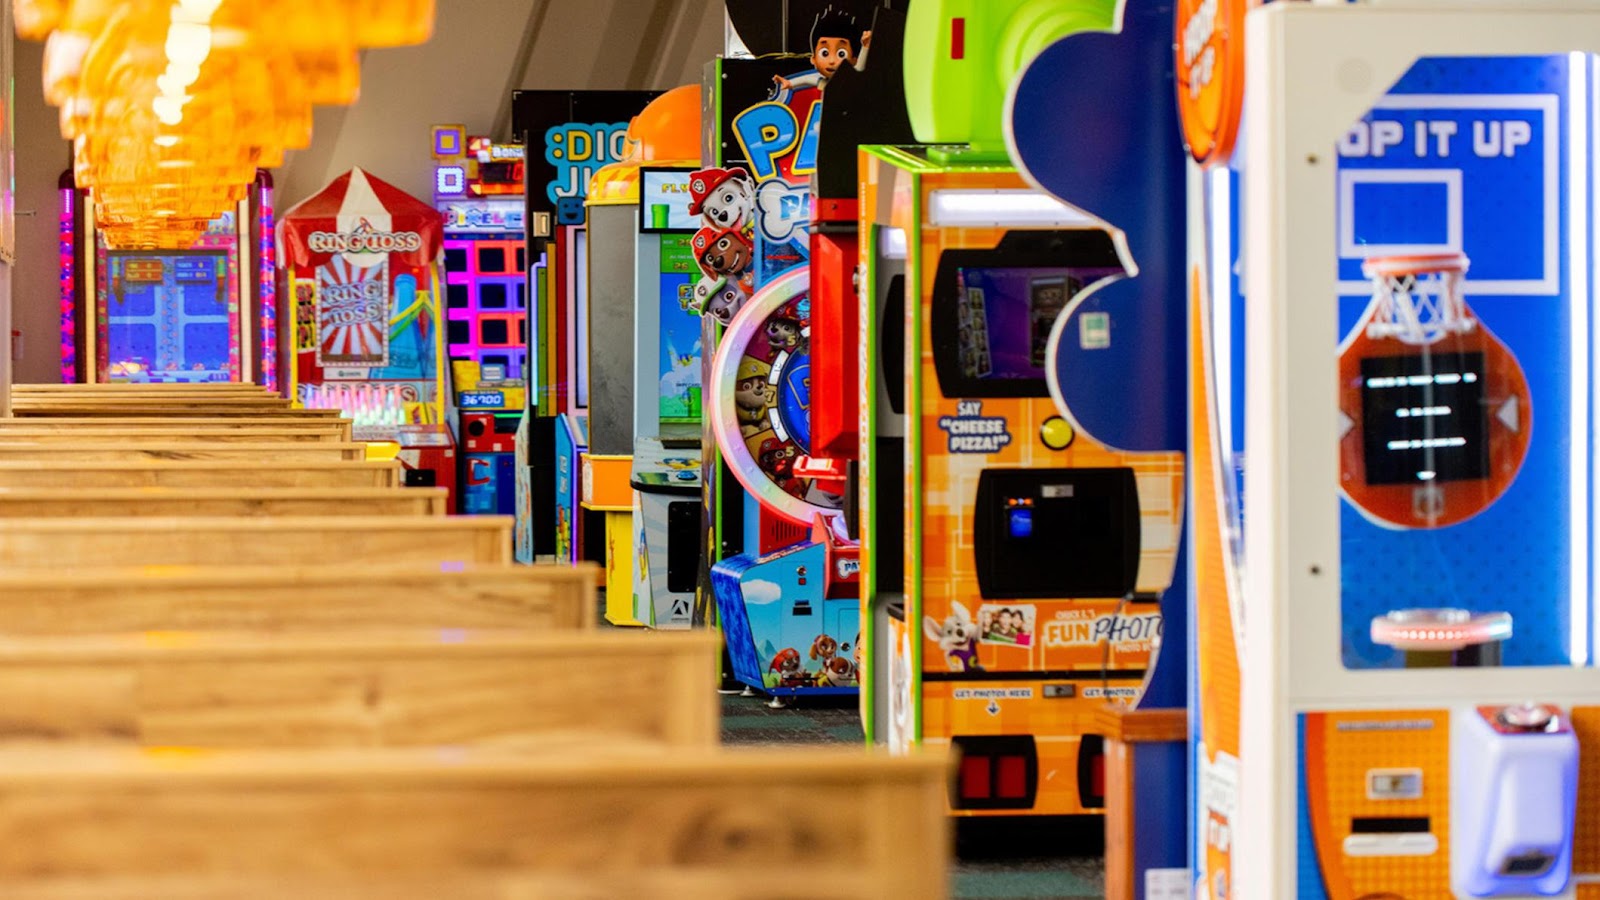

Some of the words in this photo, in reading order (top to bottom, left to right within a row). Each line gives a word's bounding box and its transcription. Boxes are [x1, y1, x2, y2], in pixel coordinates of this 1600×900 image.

[1414, 120, 1458, 158] IT
[1472, 120, 1532, 158] UP
[311, 233, 363, 251] RING
[366, 232, 420, 250] TOSS
[326, 280, 381, 303] RING
[328, 302, 382, 327] TOSS
[957, 402, 982, 416] SAY
[1048, 624, 1090, 645] FUN
